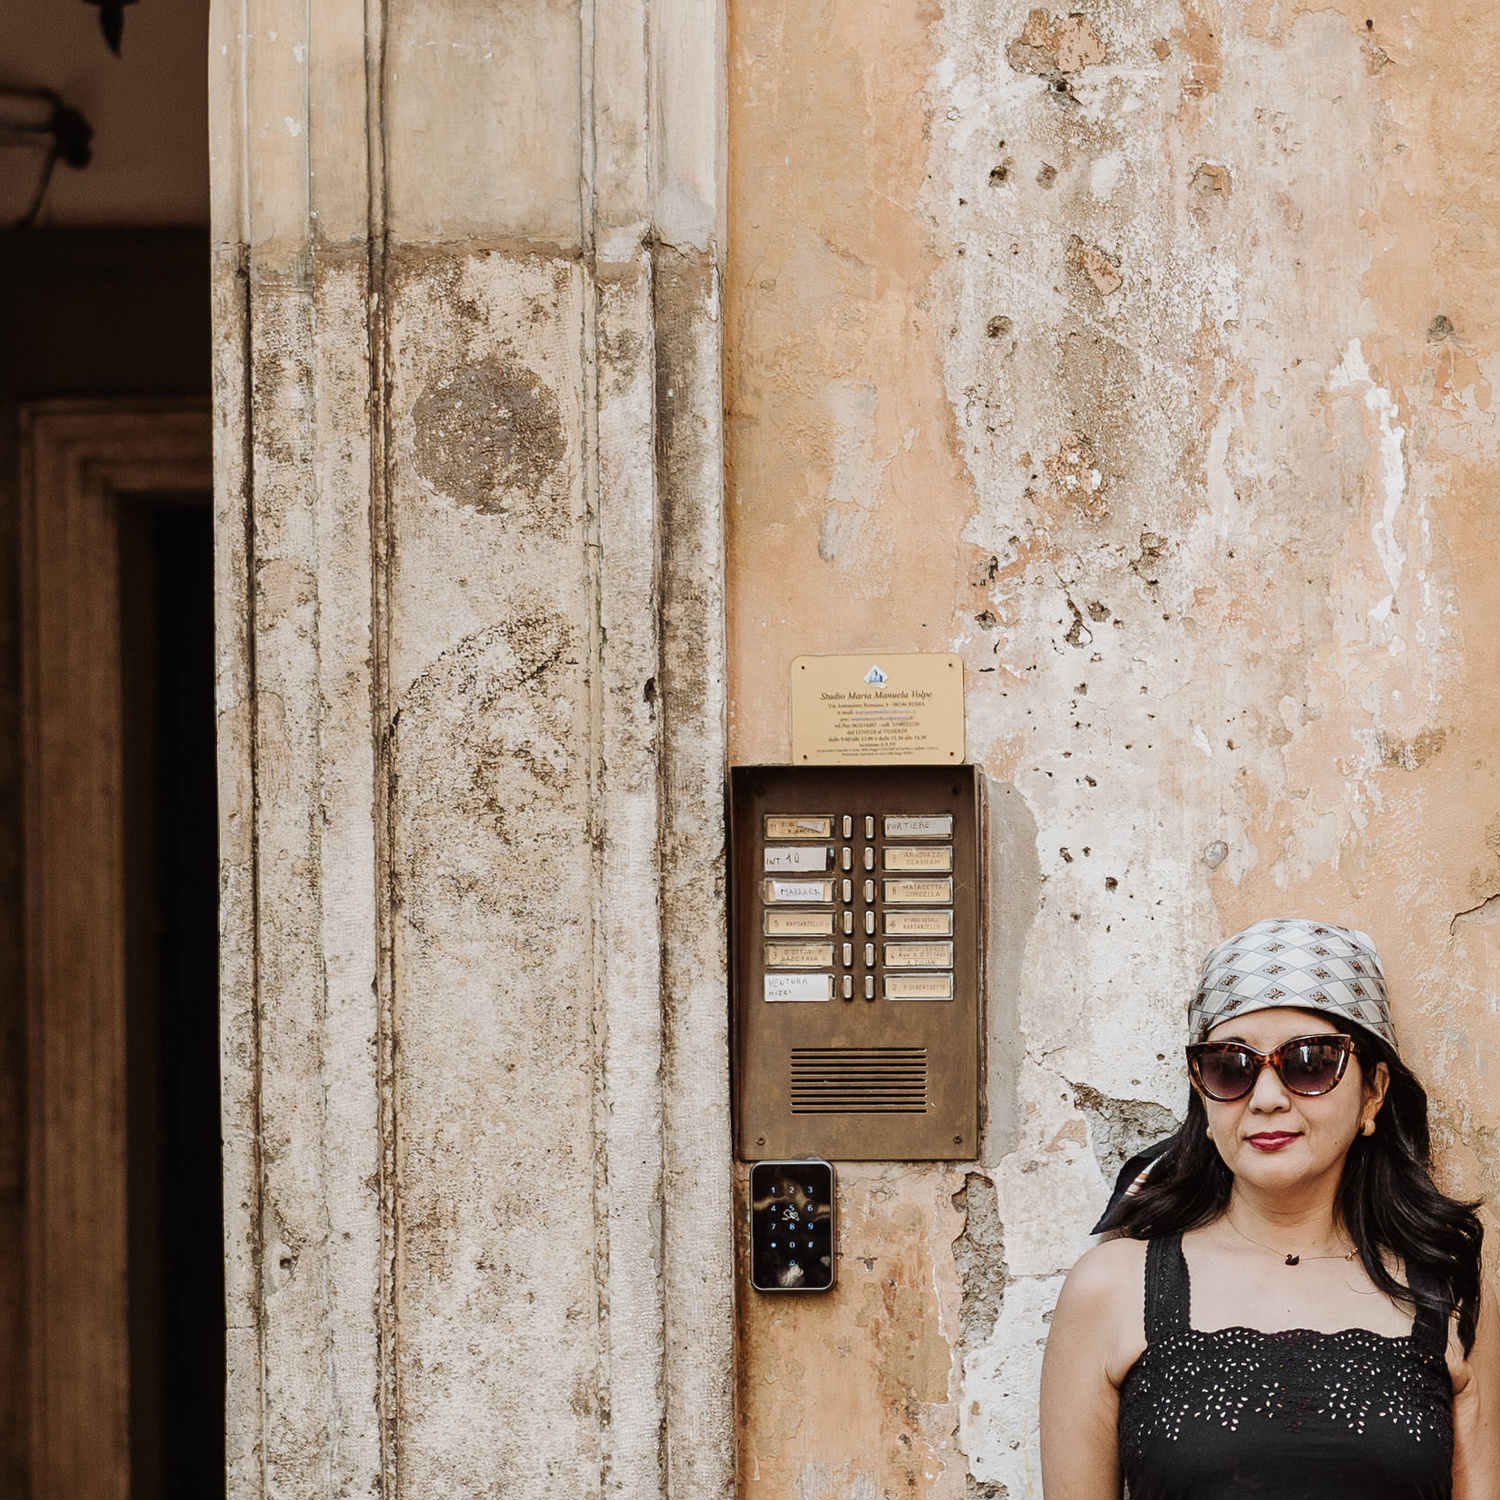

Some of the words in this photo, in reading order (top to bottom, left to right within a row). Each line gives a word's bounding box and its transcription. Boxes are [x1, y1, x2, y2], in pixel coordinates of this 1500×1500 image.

[820, 692, 846, 700] Studio
[848, 692, 872, 700] Maria
[874, 690, 909, 700] Manuela
[911, 690, 933, 700] Volpe
[771, 1186, 776, 1194] 1
[789, 1186, 795, 1194] 2
[808, 1186, 813, 1194] 3
[789, 1204, 795, 1212] 5
